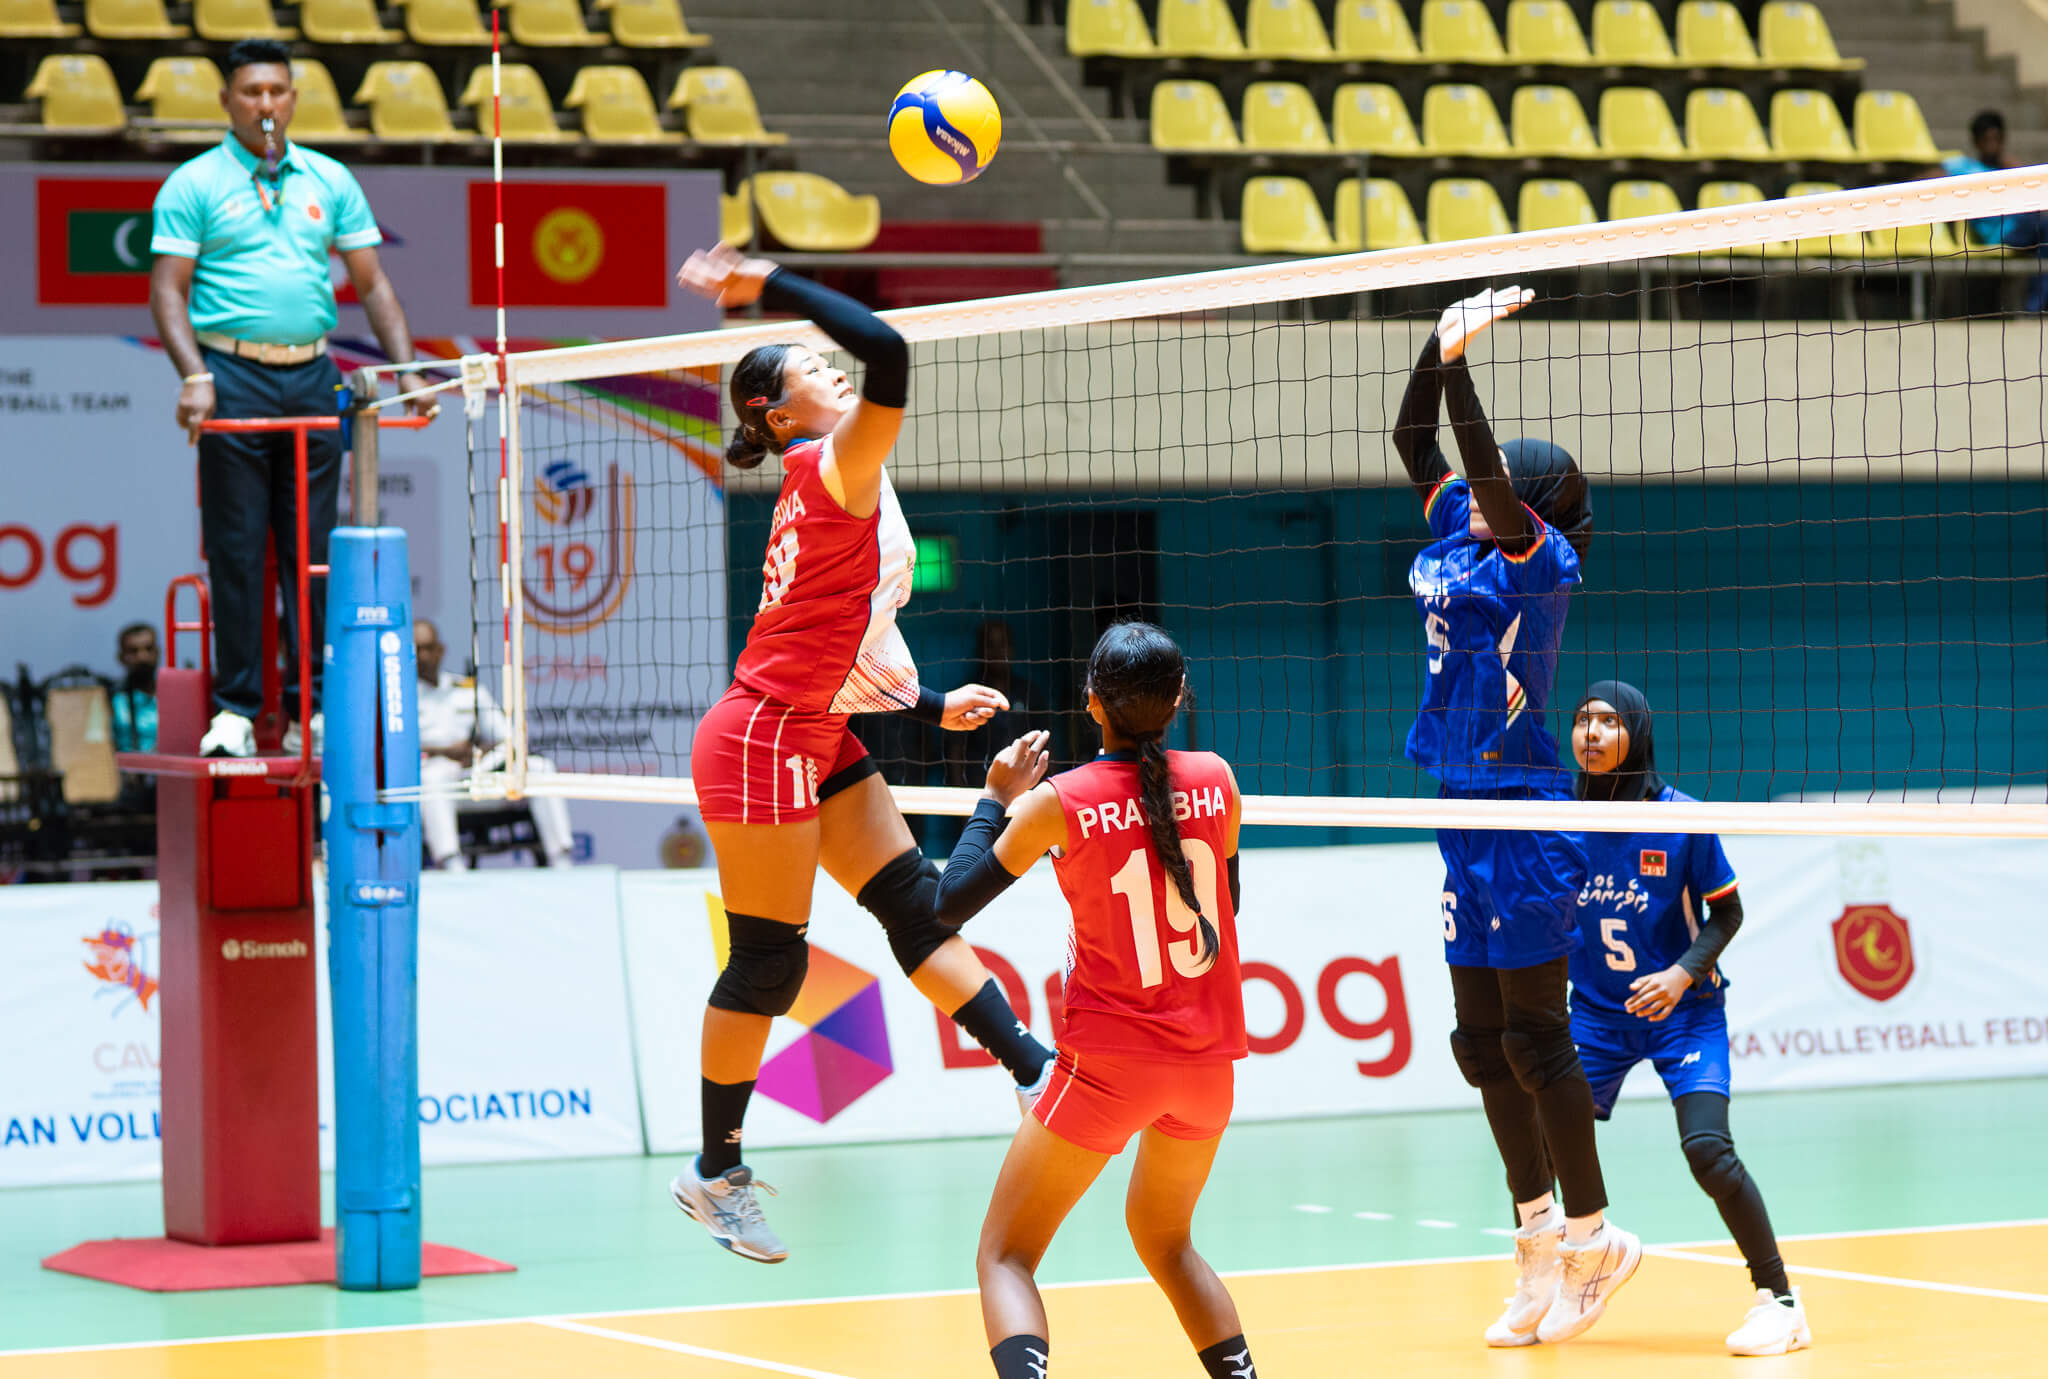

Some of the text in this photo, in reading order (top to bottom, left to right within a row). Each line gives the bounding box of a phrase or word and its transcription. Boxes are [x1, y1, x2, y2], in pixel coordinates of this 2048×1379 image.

[533, 541, 596, 594] 19
[1076, 786, 1226, 839] PRABHA
[1110, 838, 1220, 989] 19
[1600, 918, 1637, 972] 5
[1771, 1022, 1976, 1057] VOLLEYBALL
[1985, 1016, 2048, 1046] FED
